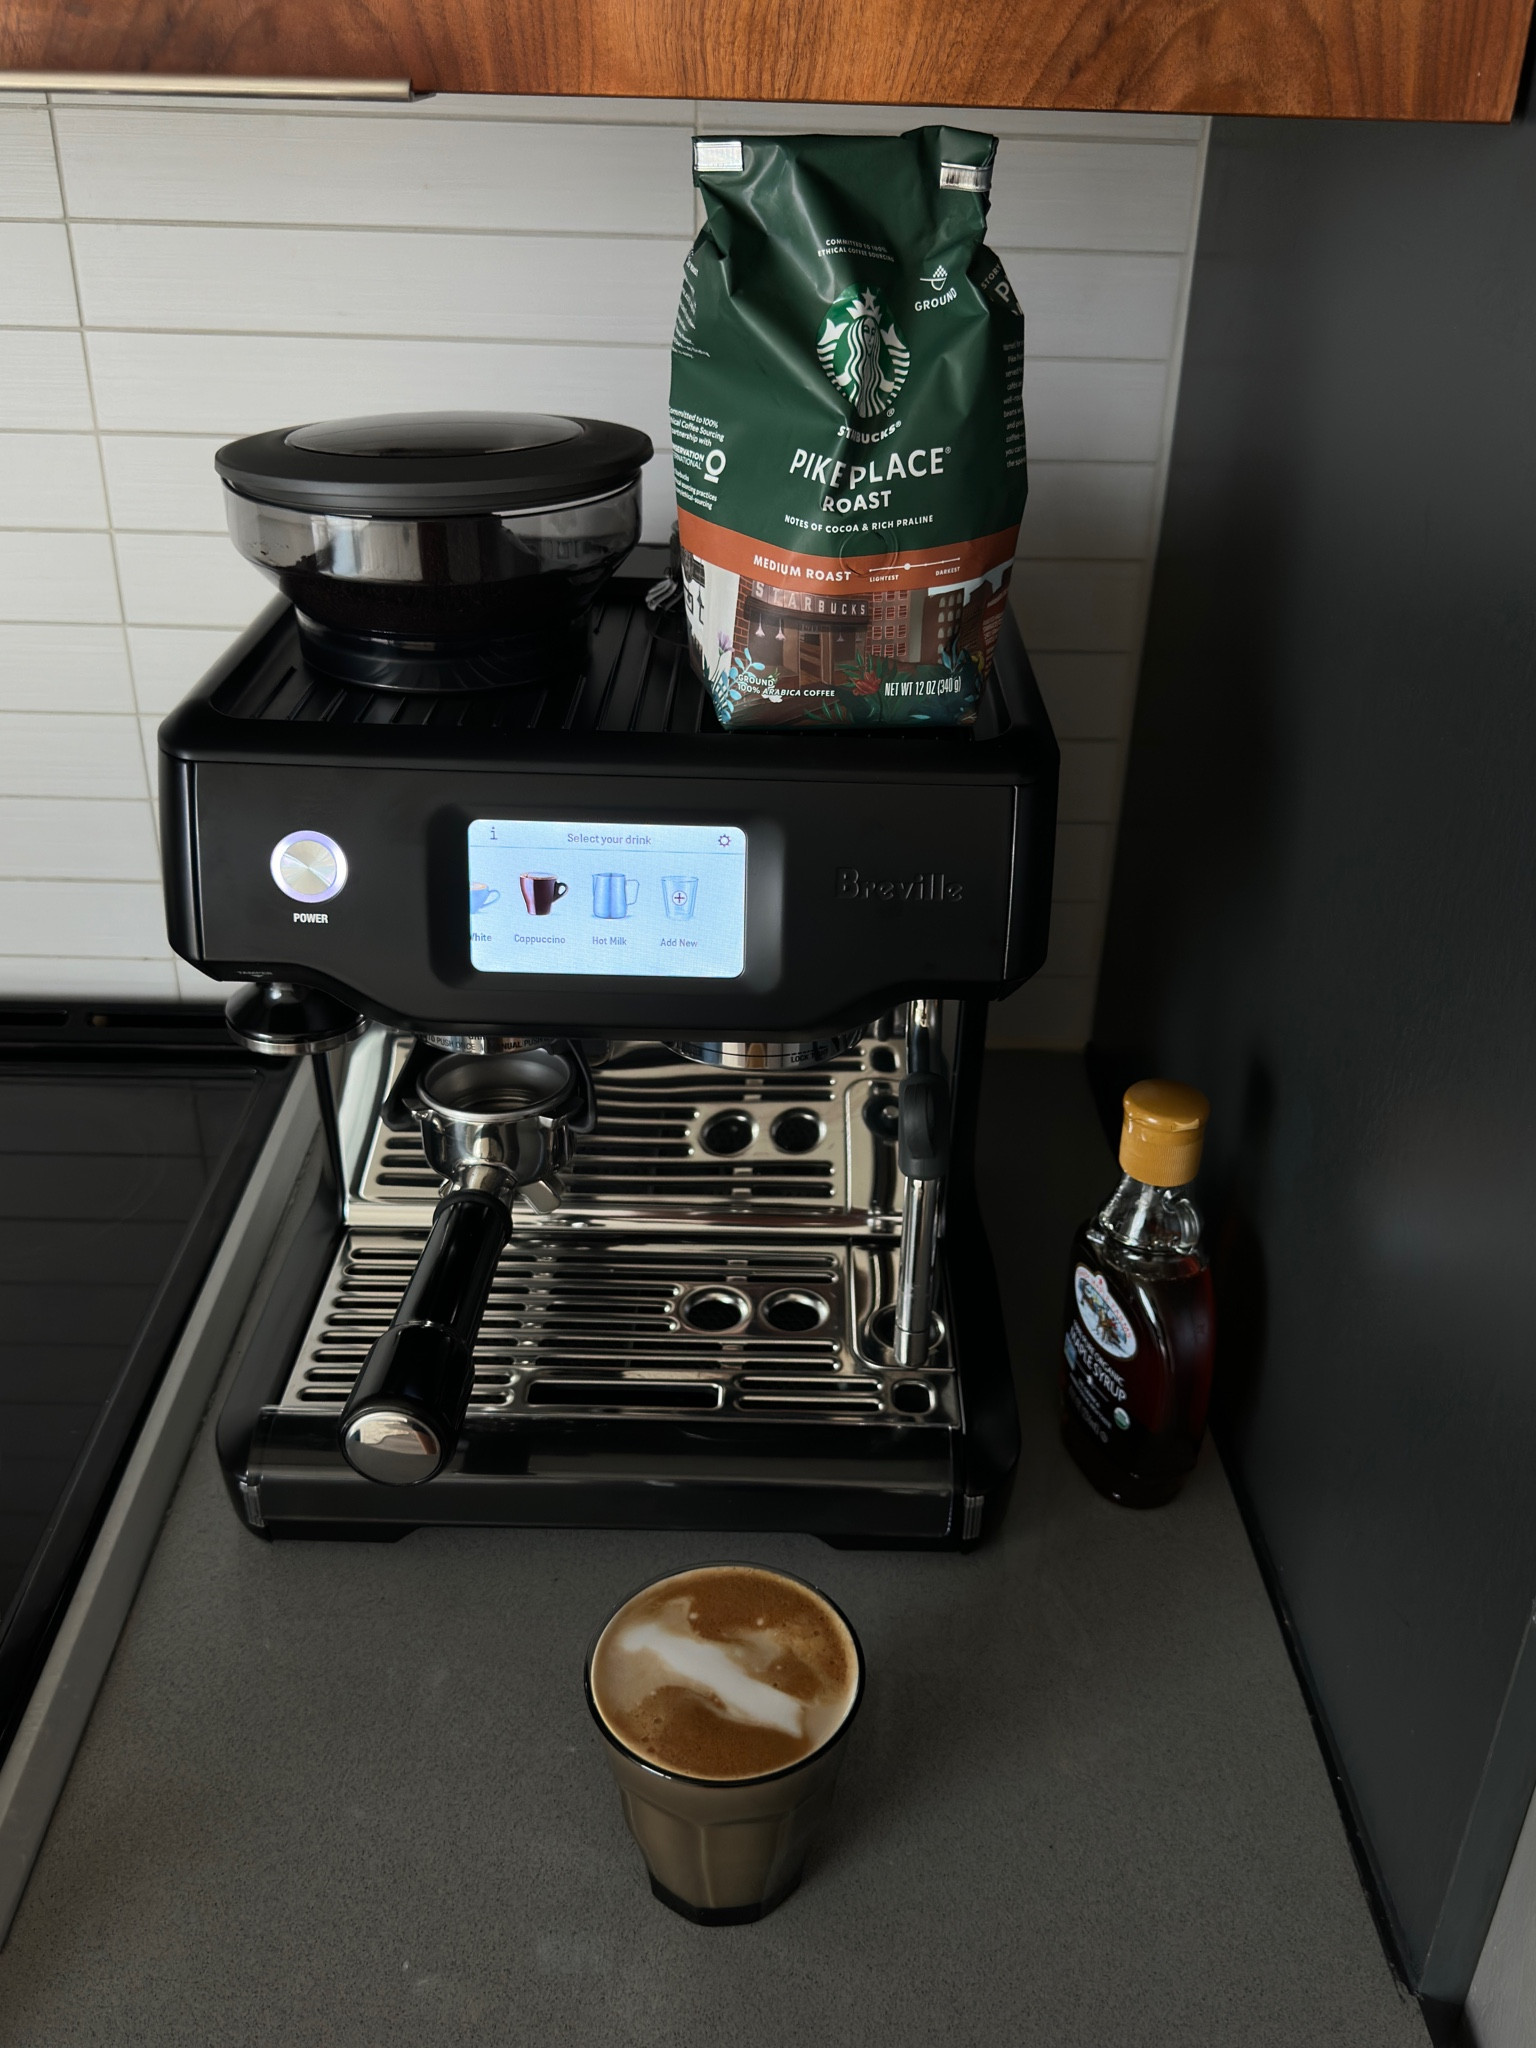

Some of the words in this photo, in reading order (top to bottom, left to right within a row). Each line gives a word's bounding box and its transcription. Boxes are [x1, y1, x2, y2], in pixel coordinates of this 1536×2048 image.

[825, 238, 864, 249] COMMITTED
[817, 246, 848, 257] ETHICAL
[914, 287, 958, 312] GROUND
[696, 415, 703, 423] to
[702, 416, 719, 429] 100%
[681, 420, 699, 433] Coffee
[699, 426, 725, 443] Sourcing
[698, 437, 712, 447] with
[789, 448, 847, 489] PIKE
[821, 489, 892, 514] ROAST
[784, 514, 809, 529] NOTES
[810, 522, 823, 532] OF
[825, 523, 860, 533] COCOA
[862, 523, 869, 532] &
[871, 520, 894, 531] RICH
[896, 514, 934, 527] PRALINE
[753, 554, 801, 577] MEDIUM
[806, 568, 852, 582] ROAST
[869, 574, 899, 583] LIGHTEST
[935, 566, 961, 577] DARKEST
[755, 581, 865, 616] STARBUCKS
[737, 674, 774, 687] GROUND
[884, 682, 900, 696] NET
[900, 681, 914, 696] WT
[915, 680, 925, 696] 12
[925, 680, 937, 696] OZ
[937, 677, 953, 696] (340
[953, 675, 962, 694] g)
[737, 684, 761, 694] 100%
[762, 688, 801, 697] ARABICA
[803, 689, 835, 697] COFFEE
[567, 833, 599, 844] Select
[601, 835, 623, 846] your
[625, 835, 652, 845] drink
[835, 866, 964, 901] Breville
[292, 912, 329, 924] POWER
[514, 933, 566, 944] Cappuccino
[592, 936, 608, 945] Hot
[609, 936, 627, 946] Milk
[660, 937, 677, 947] Add
[679, 938, 698, 948] New
[791, 1054, 809, 1063] LOCK
[1093, 1362, 1128, 1402] SYRUP
